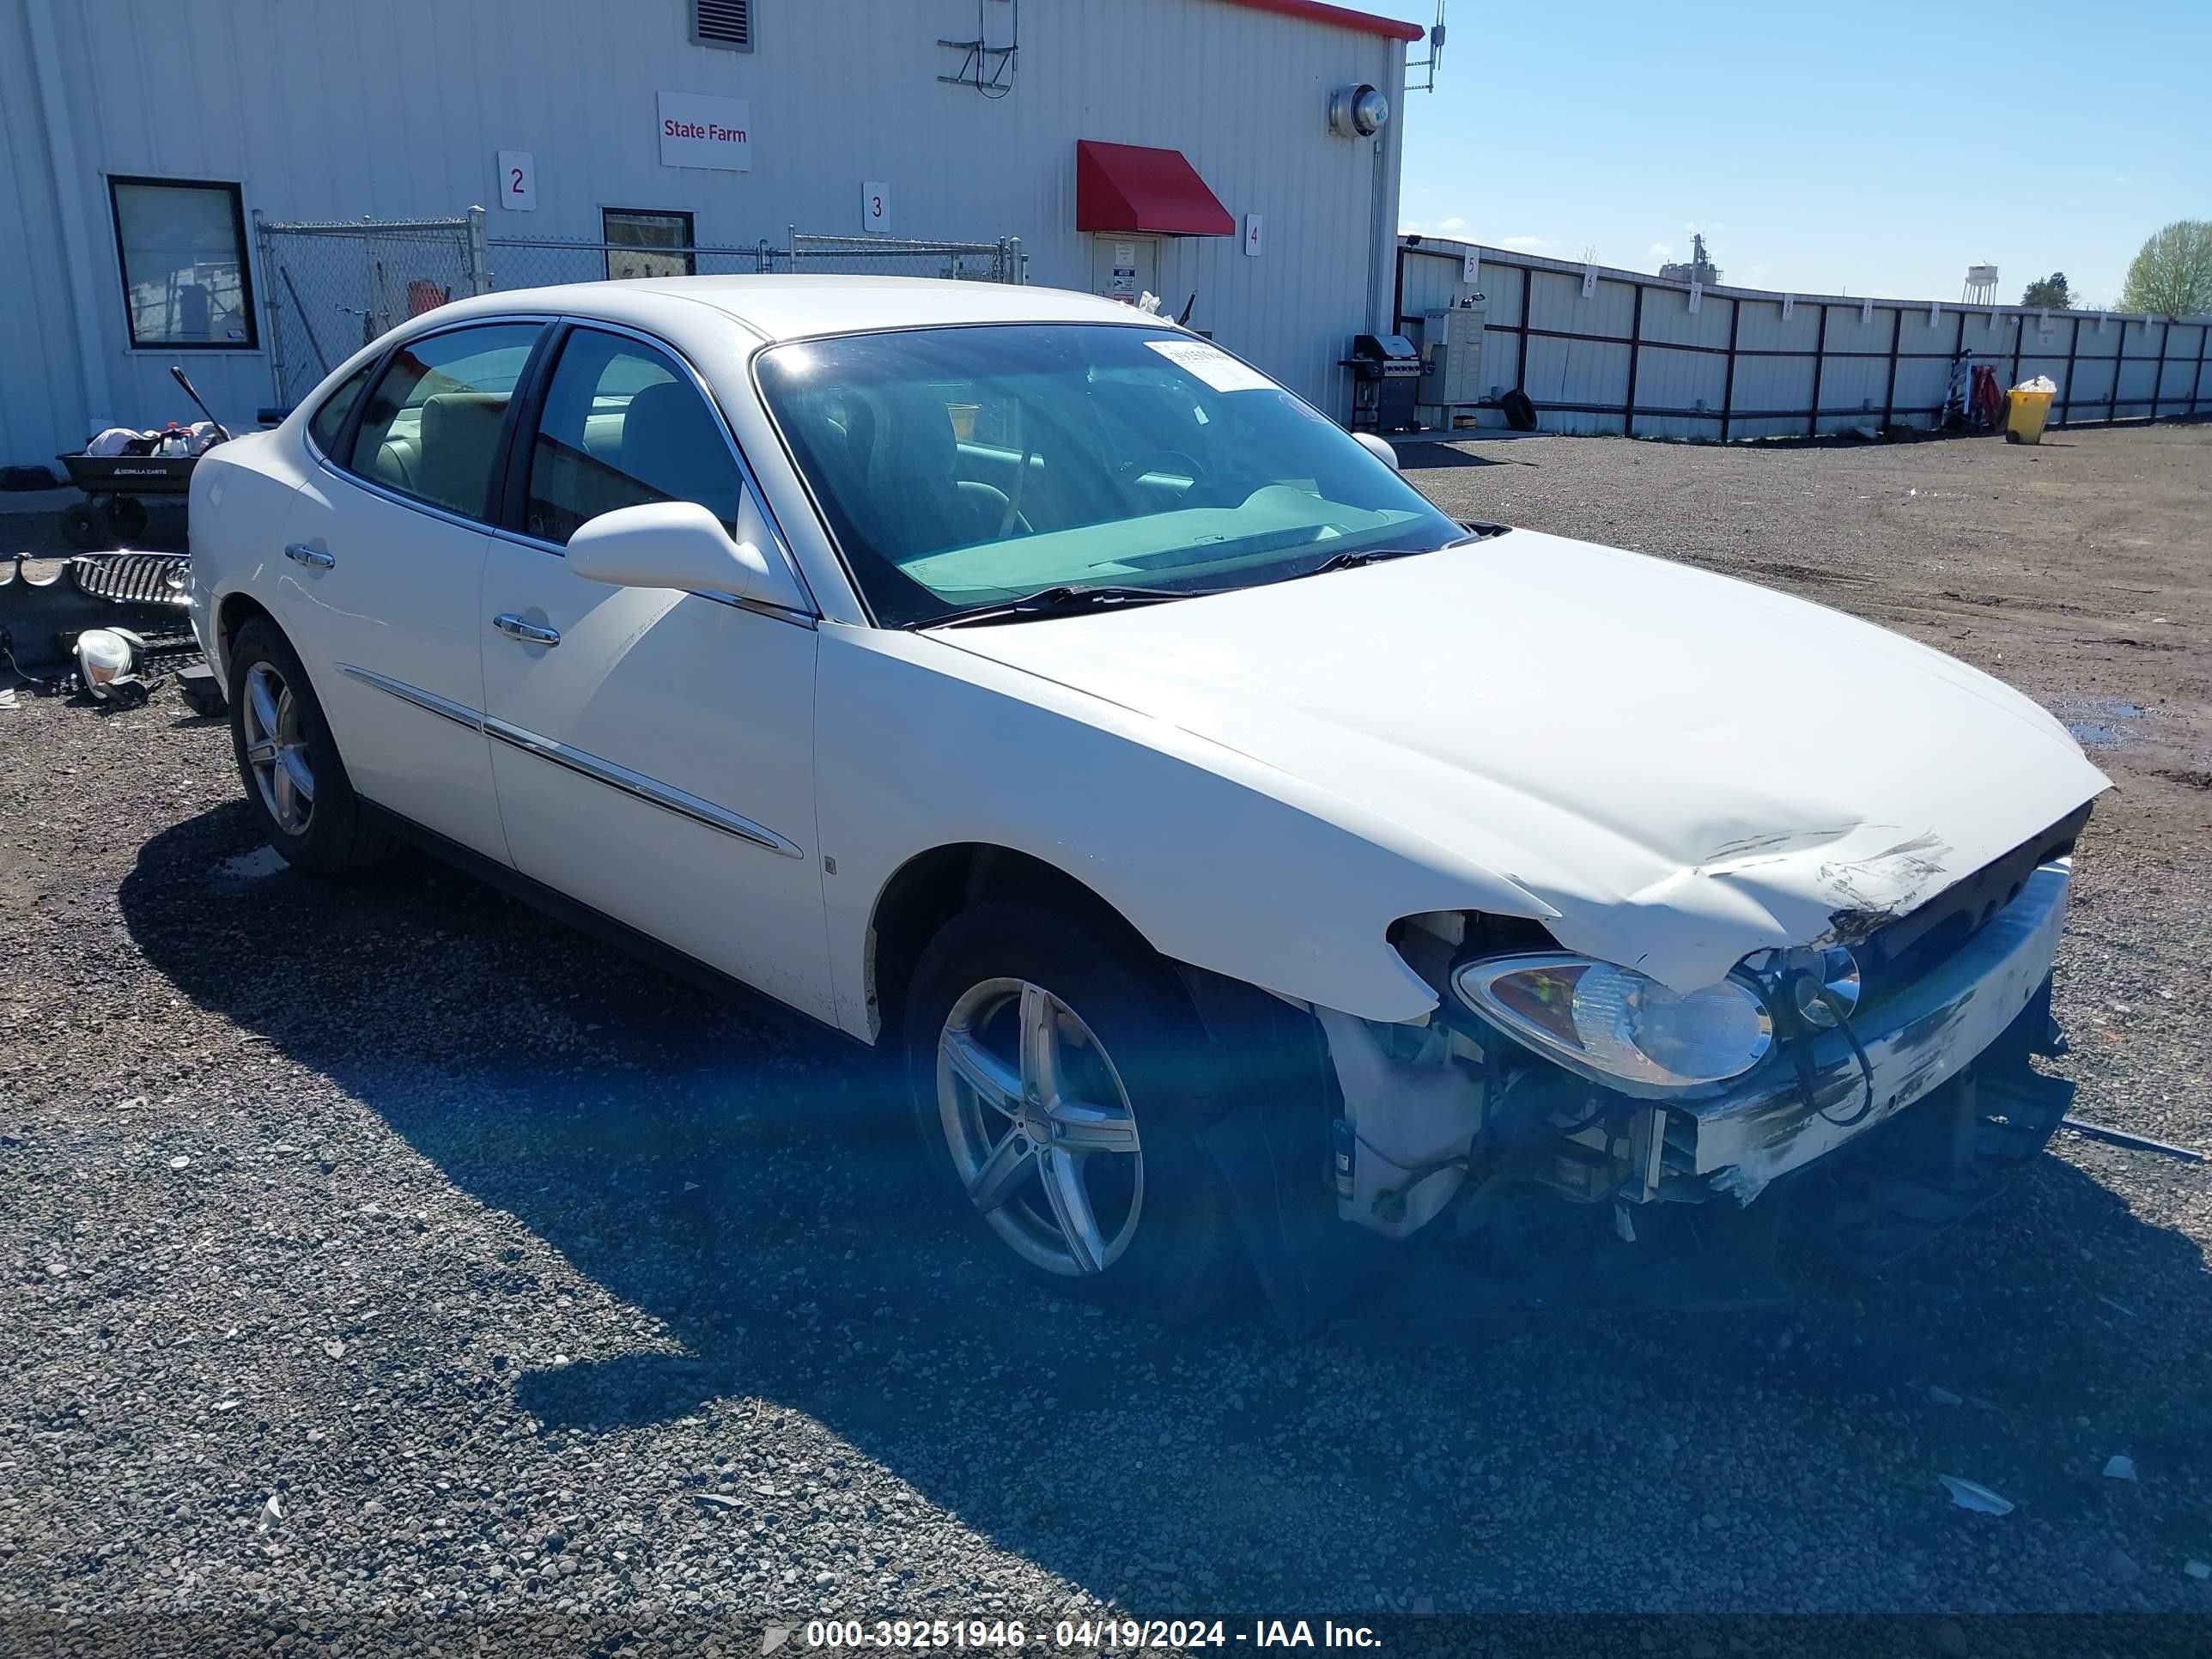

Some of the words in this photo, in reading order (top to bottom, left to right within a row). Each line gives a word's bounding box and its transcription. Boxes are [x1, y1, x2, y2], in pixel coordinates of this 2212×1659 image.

[665, 119, 705, 139] State
[709, 124, 747, 143] Farm
[511, 168, 525, 193] 2
[872, 197, 882, 217] 3
[1251, 226, 1257, 245] 4
[1468, 257, 1474, 272] 5
[1587, 274, 1593, 288] 6
[1693, 291, 1698, 303] 7
